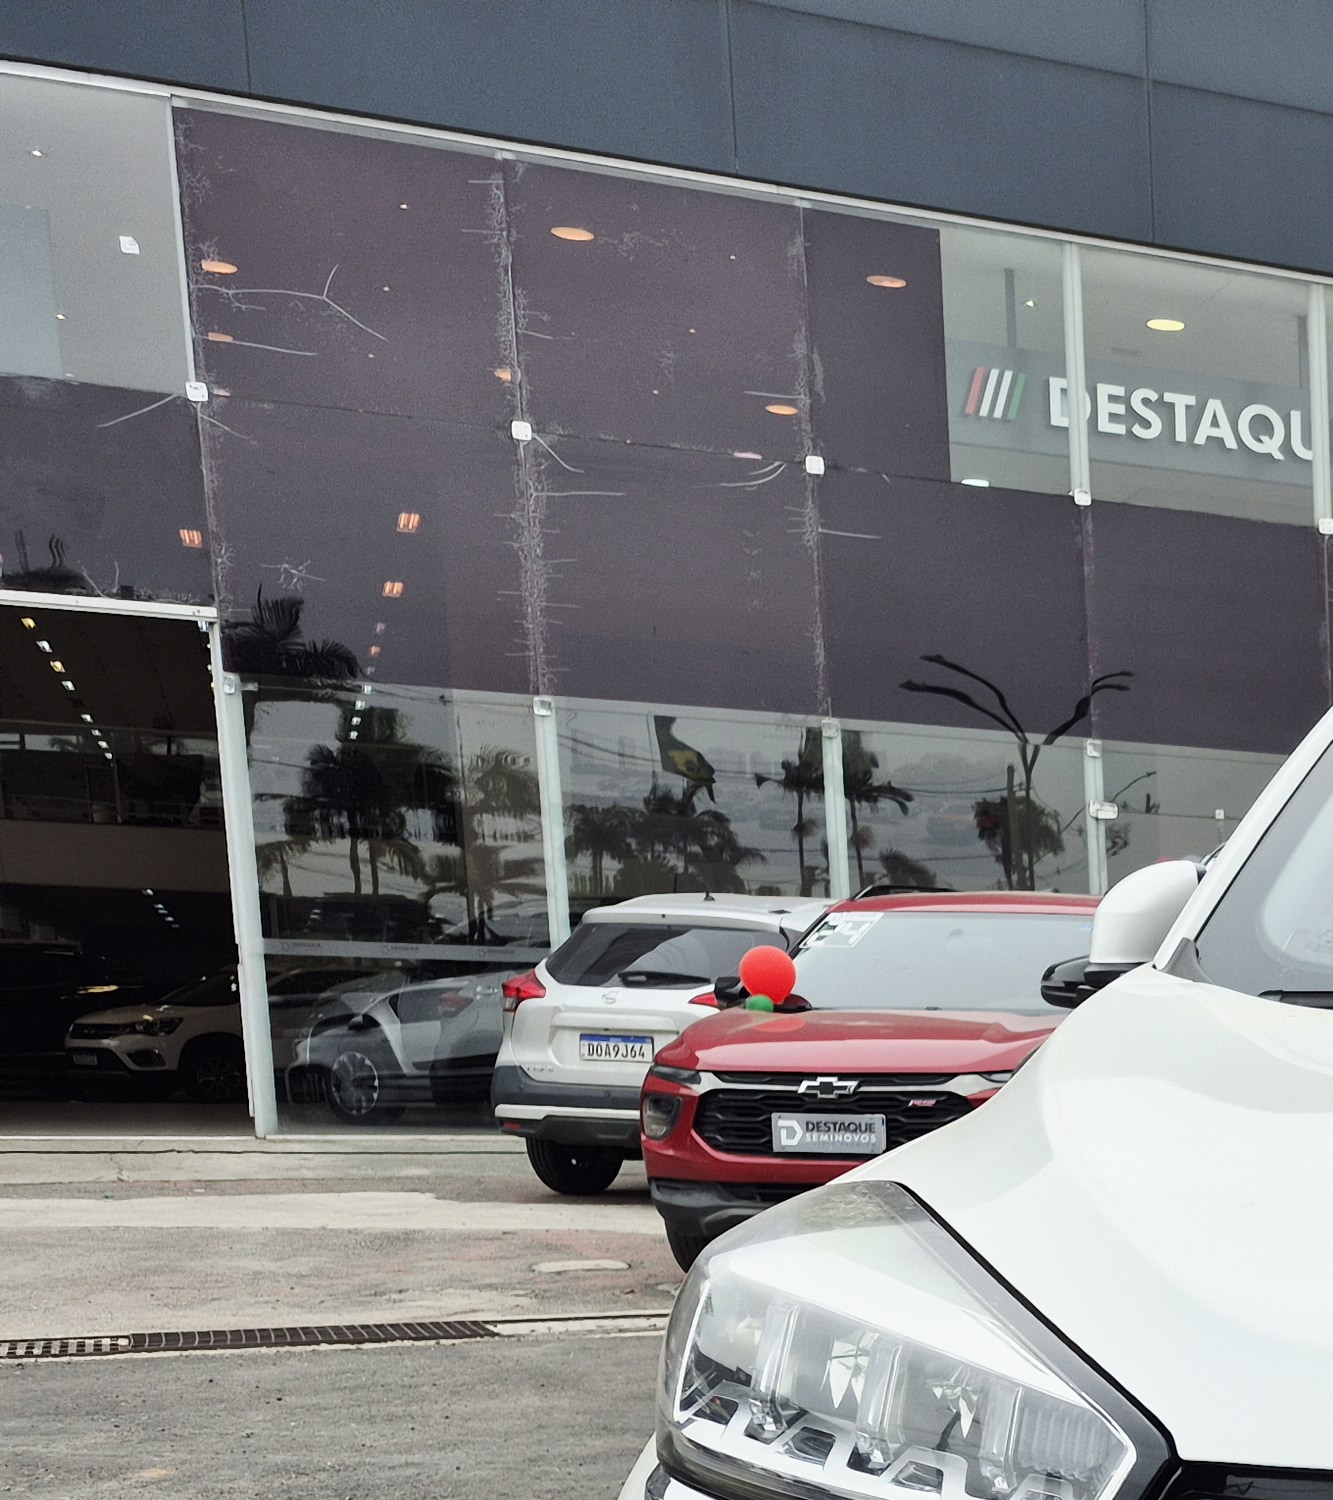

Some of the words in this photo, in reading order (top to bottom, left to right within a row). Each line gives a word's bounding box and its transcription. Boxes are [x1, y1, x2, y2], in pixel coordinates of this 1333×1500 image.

[586, 1042, 646, 1059] DOA9J64
[805, 1120, 876, 1133] DESTAQUE
[804, 1132, 877, 1144] SEMINOVOS
